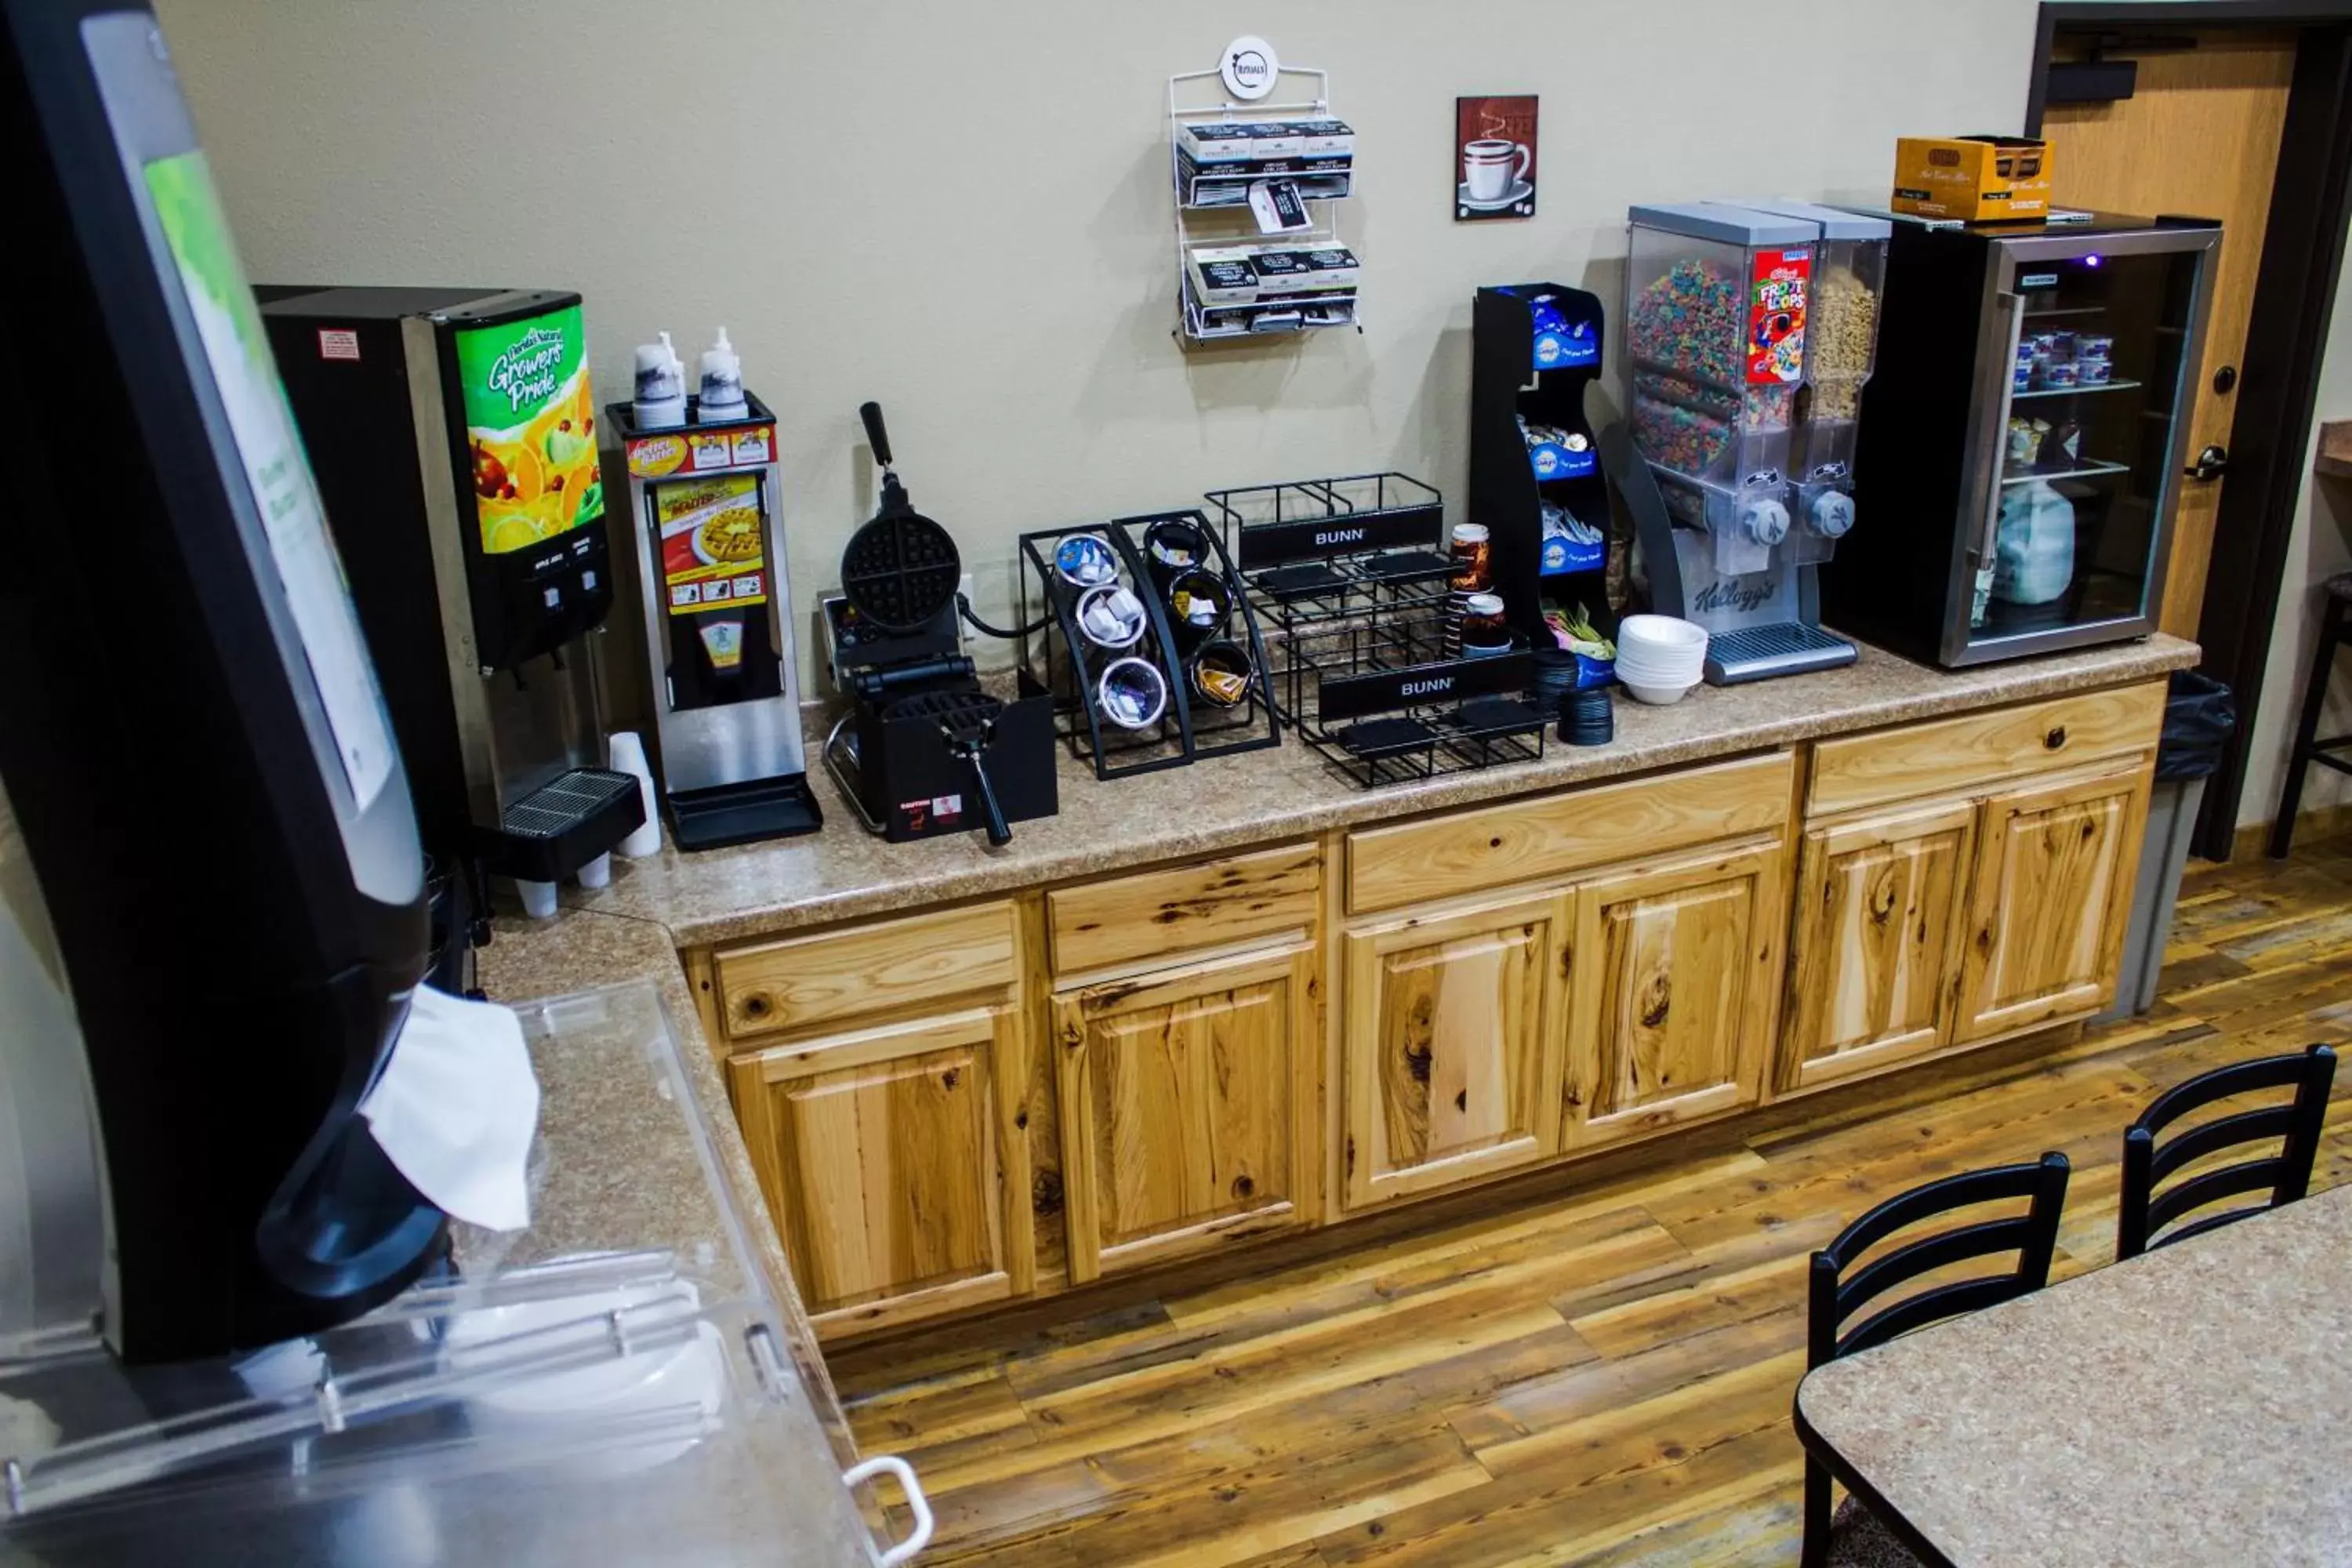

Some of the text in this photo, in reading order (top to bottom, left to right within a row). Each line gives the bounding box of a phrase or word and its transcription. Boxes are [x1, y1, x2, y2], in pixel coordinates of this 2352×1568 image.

[1760, 279, 1807, 302] FROOT
[1767, 292, 1806, 310] LOOPS
[508, 368, 556, 413] Pride
[1315, 529, 1365, 546] BUNN
[1694, 579, 1776, 614] Kellogg's
[1401, 677, 1452, 696] BUNN
